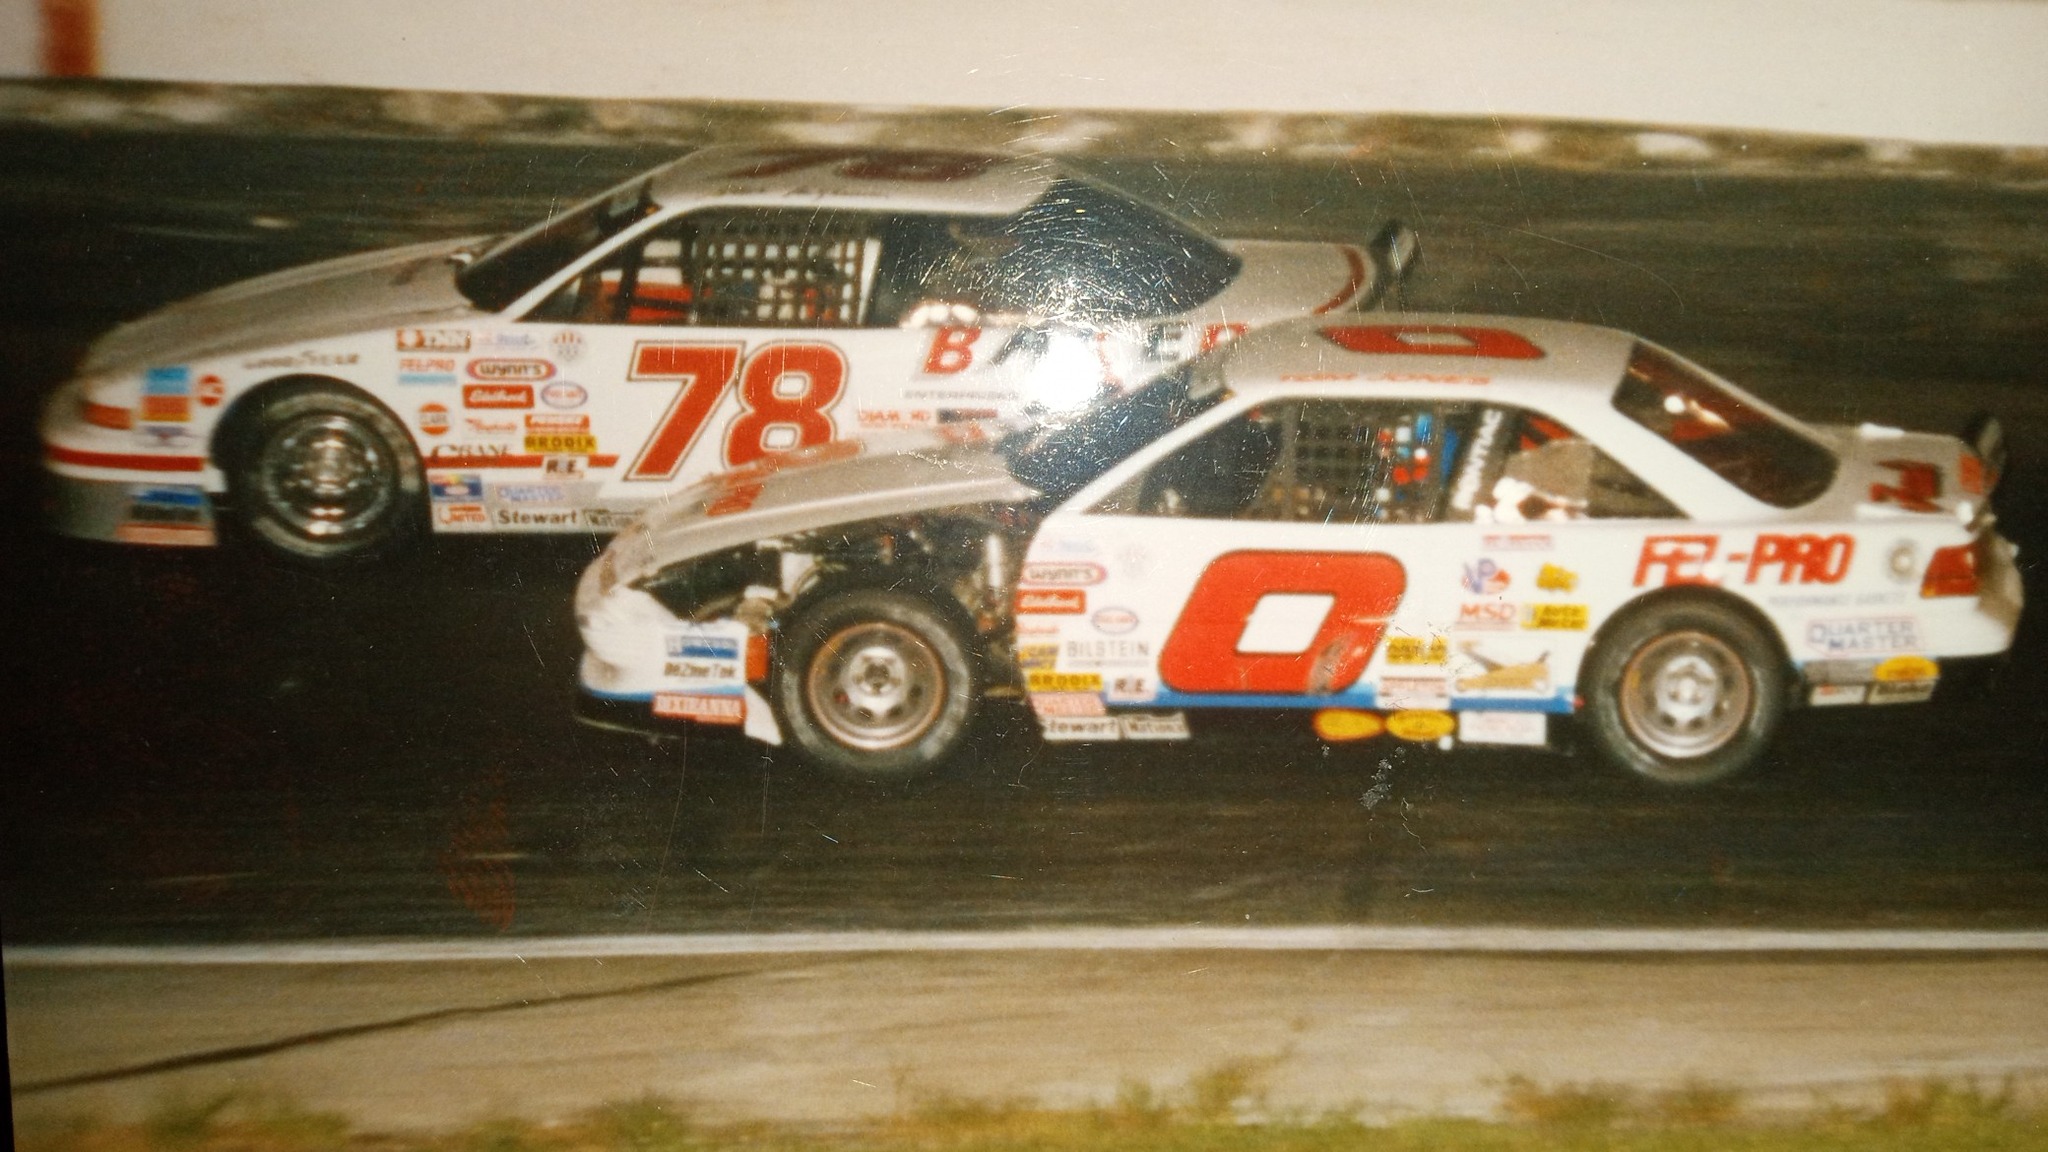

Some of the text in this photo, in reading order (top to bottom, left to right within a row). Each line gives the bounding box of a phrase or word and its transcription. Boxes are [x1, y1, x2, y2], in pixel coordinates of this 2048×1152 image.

[622, 339, 849, 482] 78
[498, 508, 578, 525] Stewart
[1067, 640, 1149, 659] BILSTEIN
[1157, 548, 1408, 694] 0
